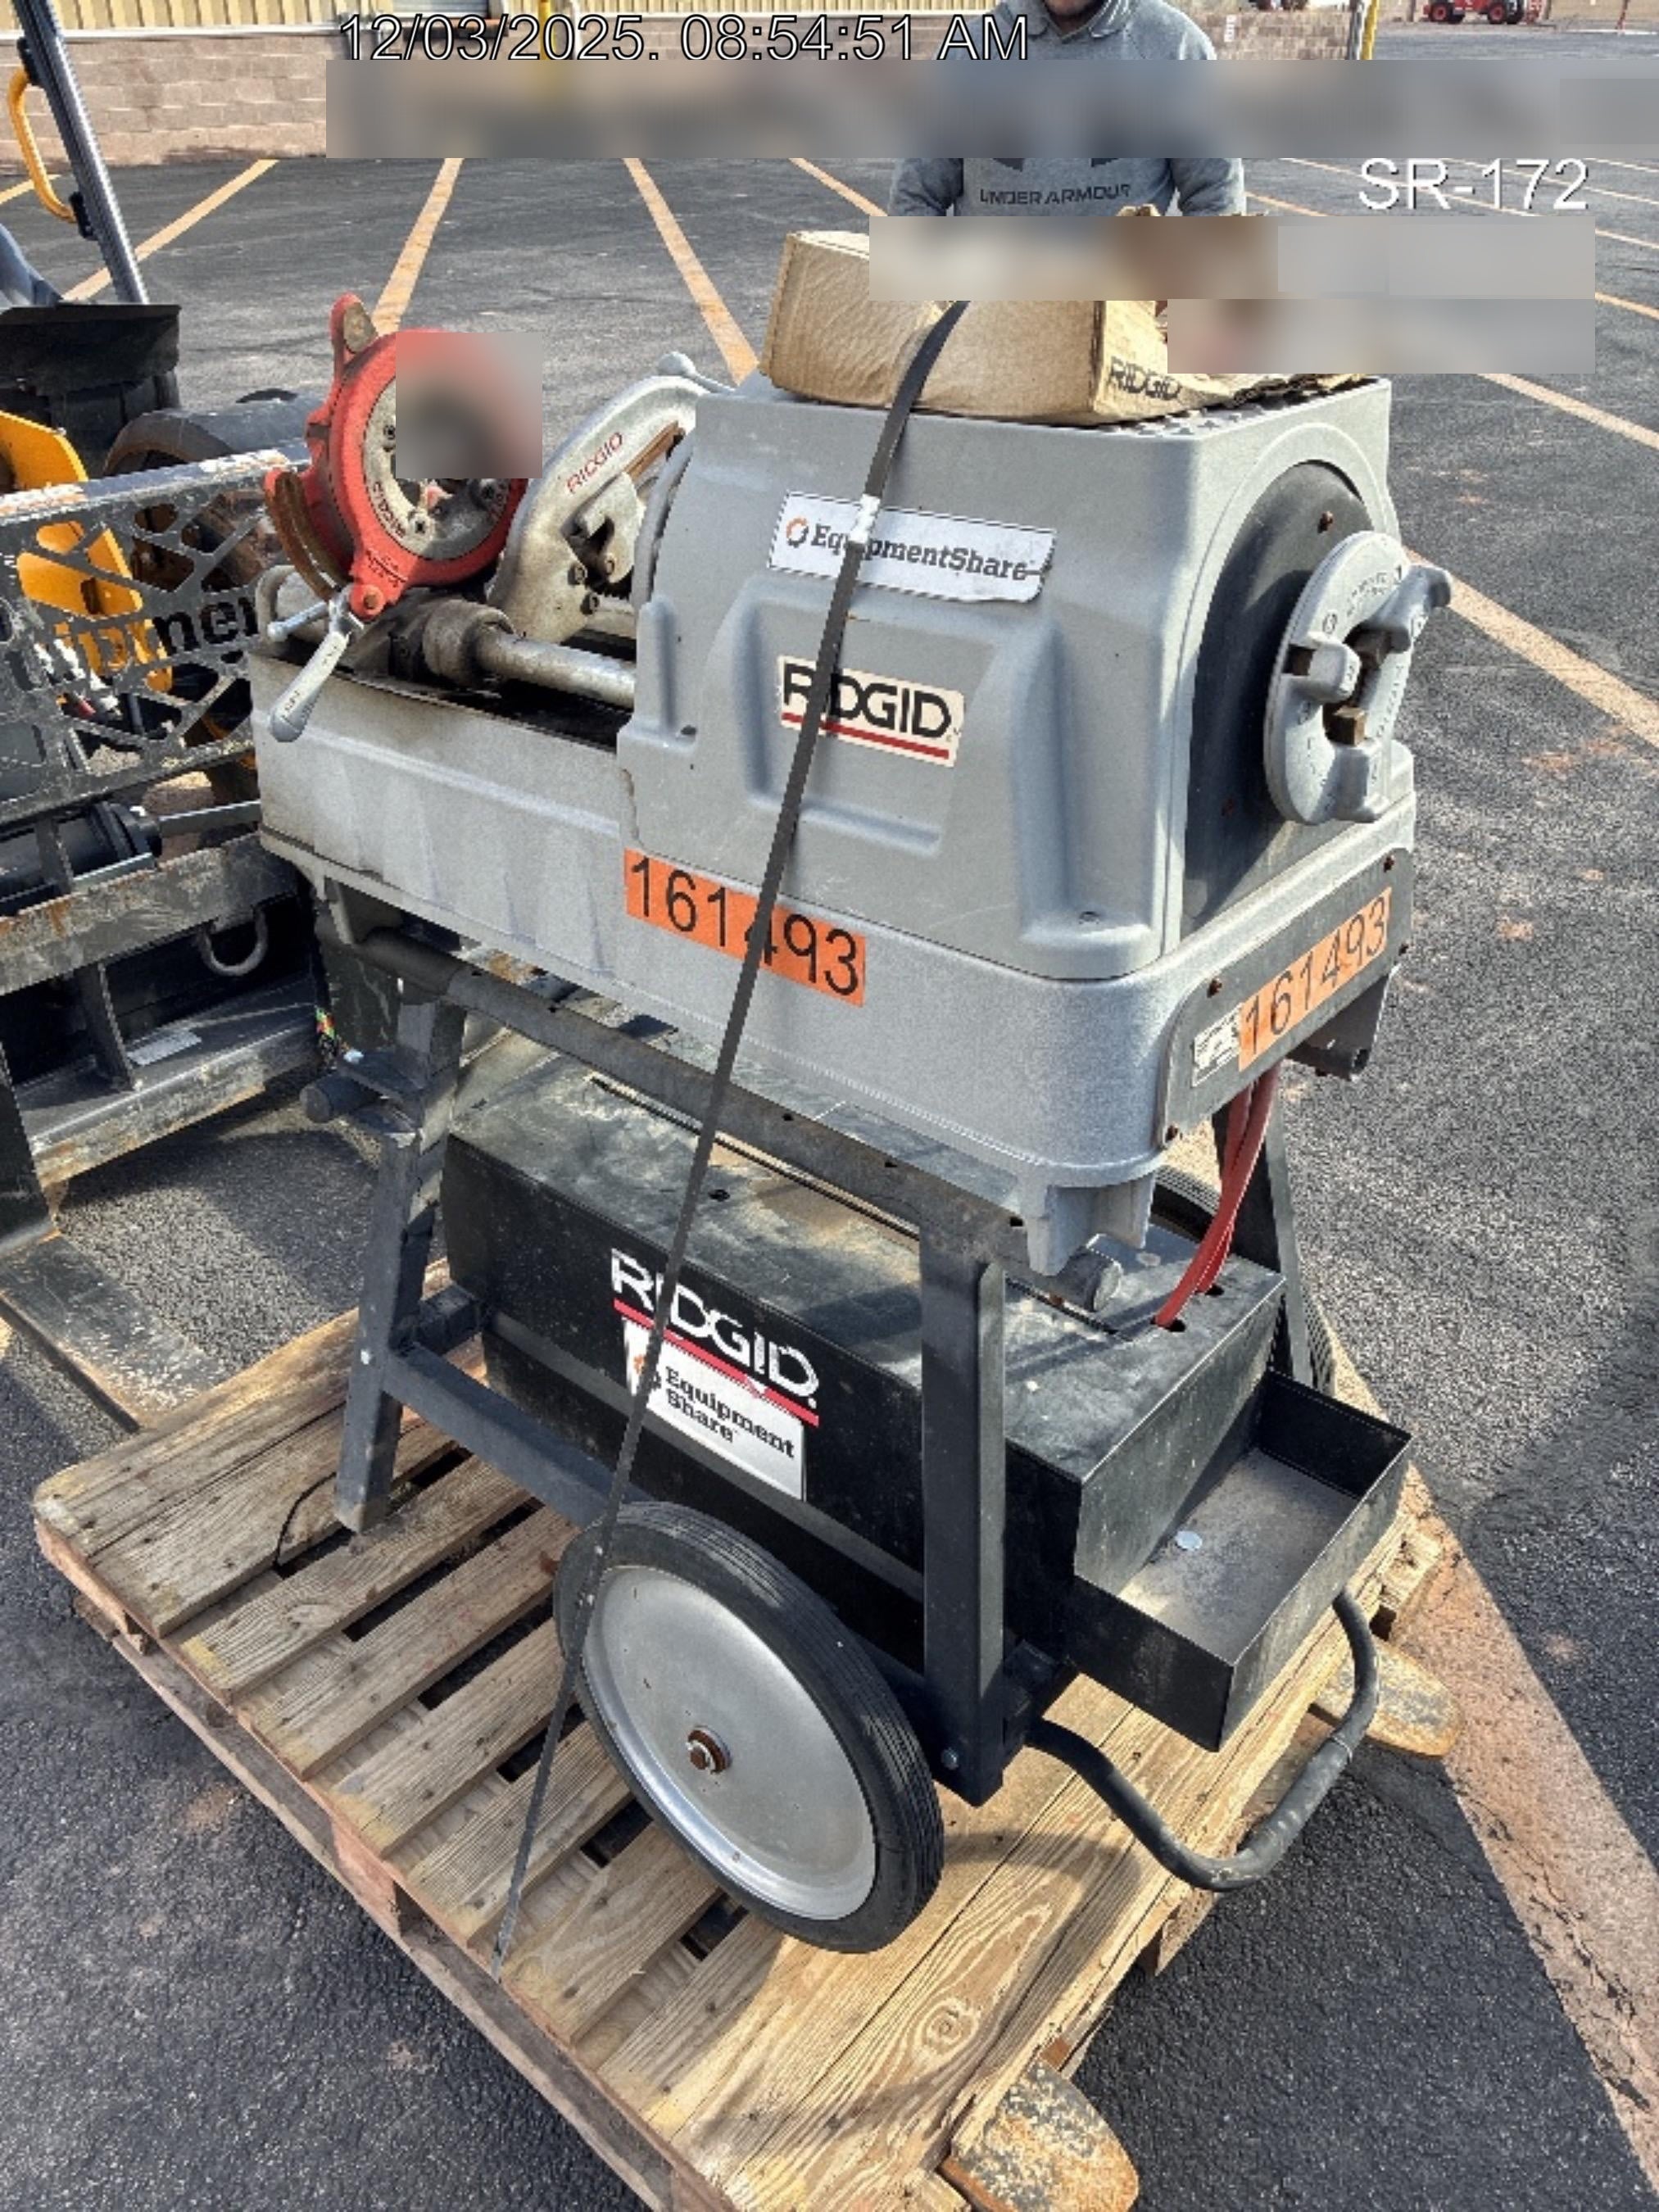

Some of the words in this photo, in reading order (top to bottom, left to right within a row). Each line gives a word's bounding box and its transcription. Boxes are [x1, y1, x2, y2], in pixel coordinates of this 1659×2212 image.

[1108, 356, 1183, 401] RIDGID
[810, 523, 1028, 582] EqpmentShare
[783, 663, 953, 738] RDGID
[1245, 896, 1385, 1055] 161493
[665, 1366, 796, 1459] Equipment
[667, 1387, 735, 1444] Share
